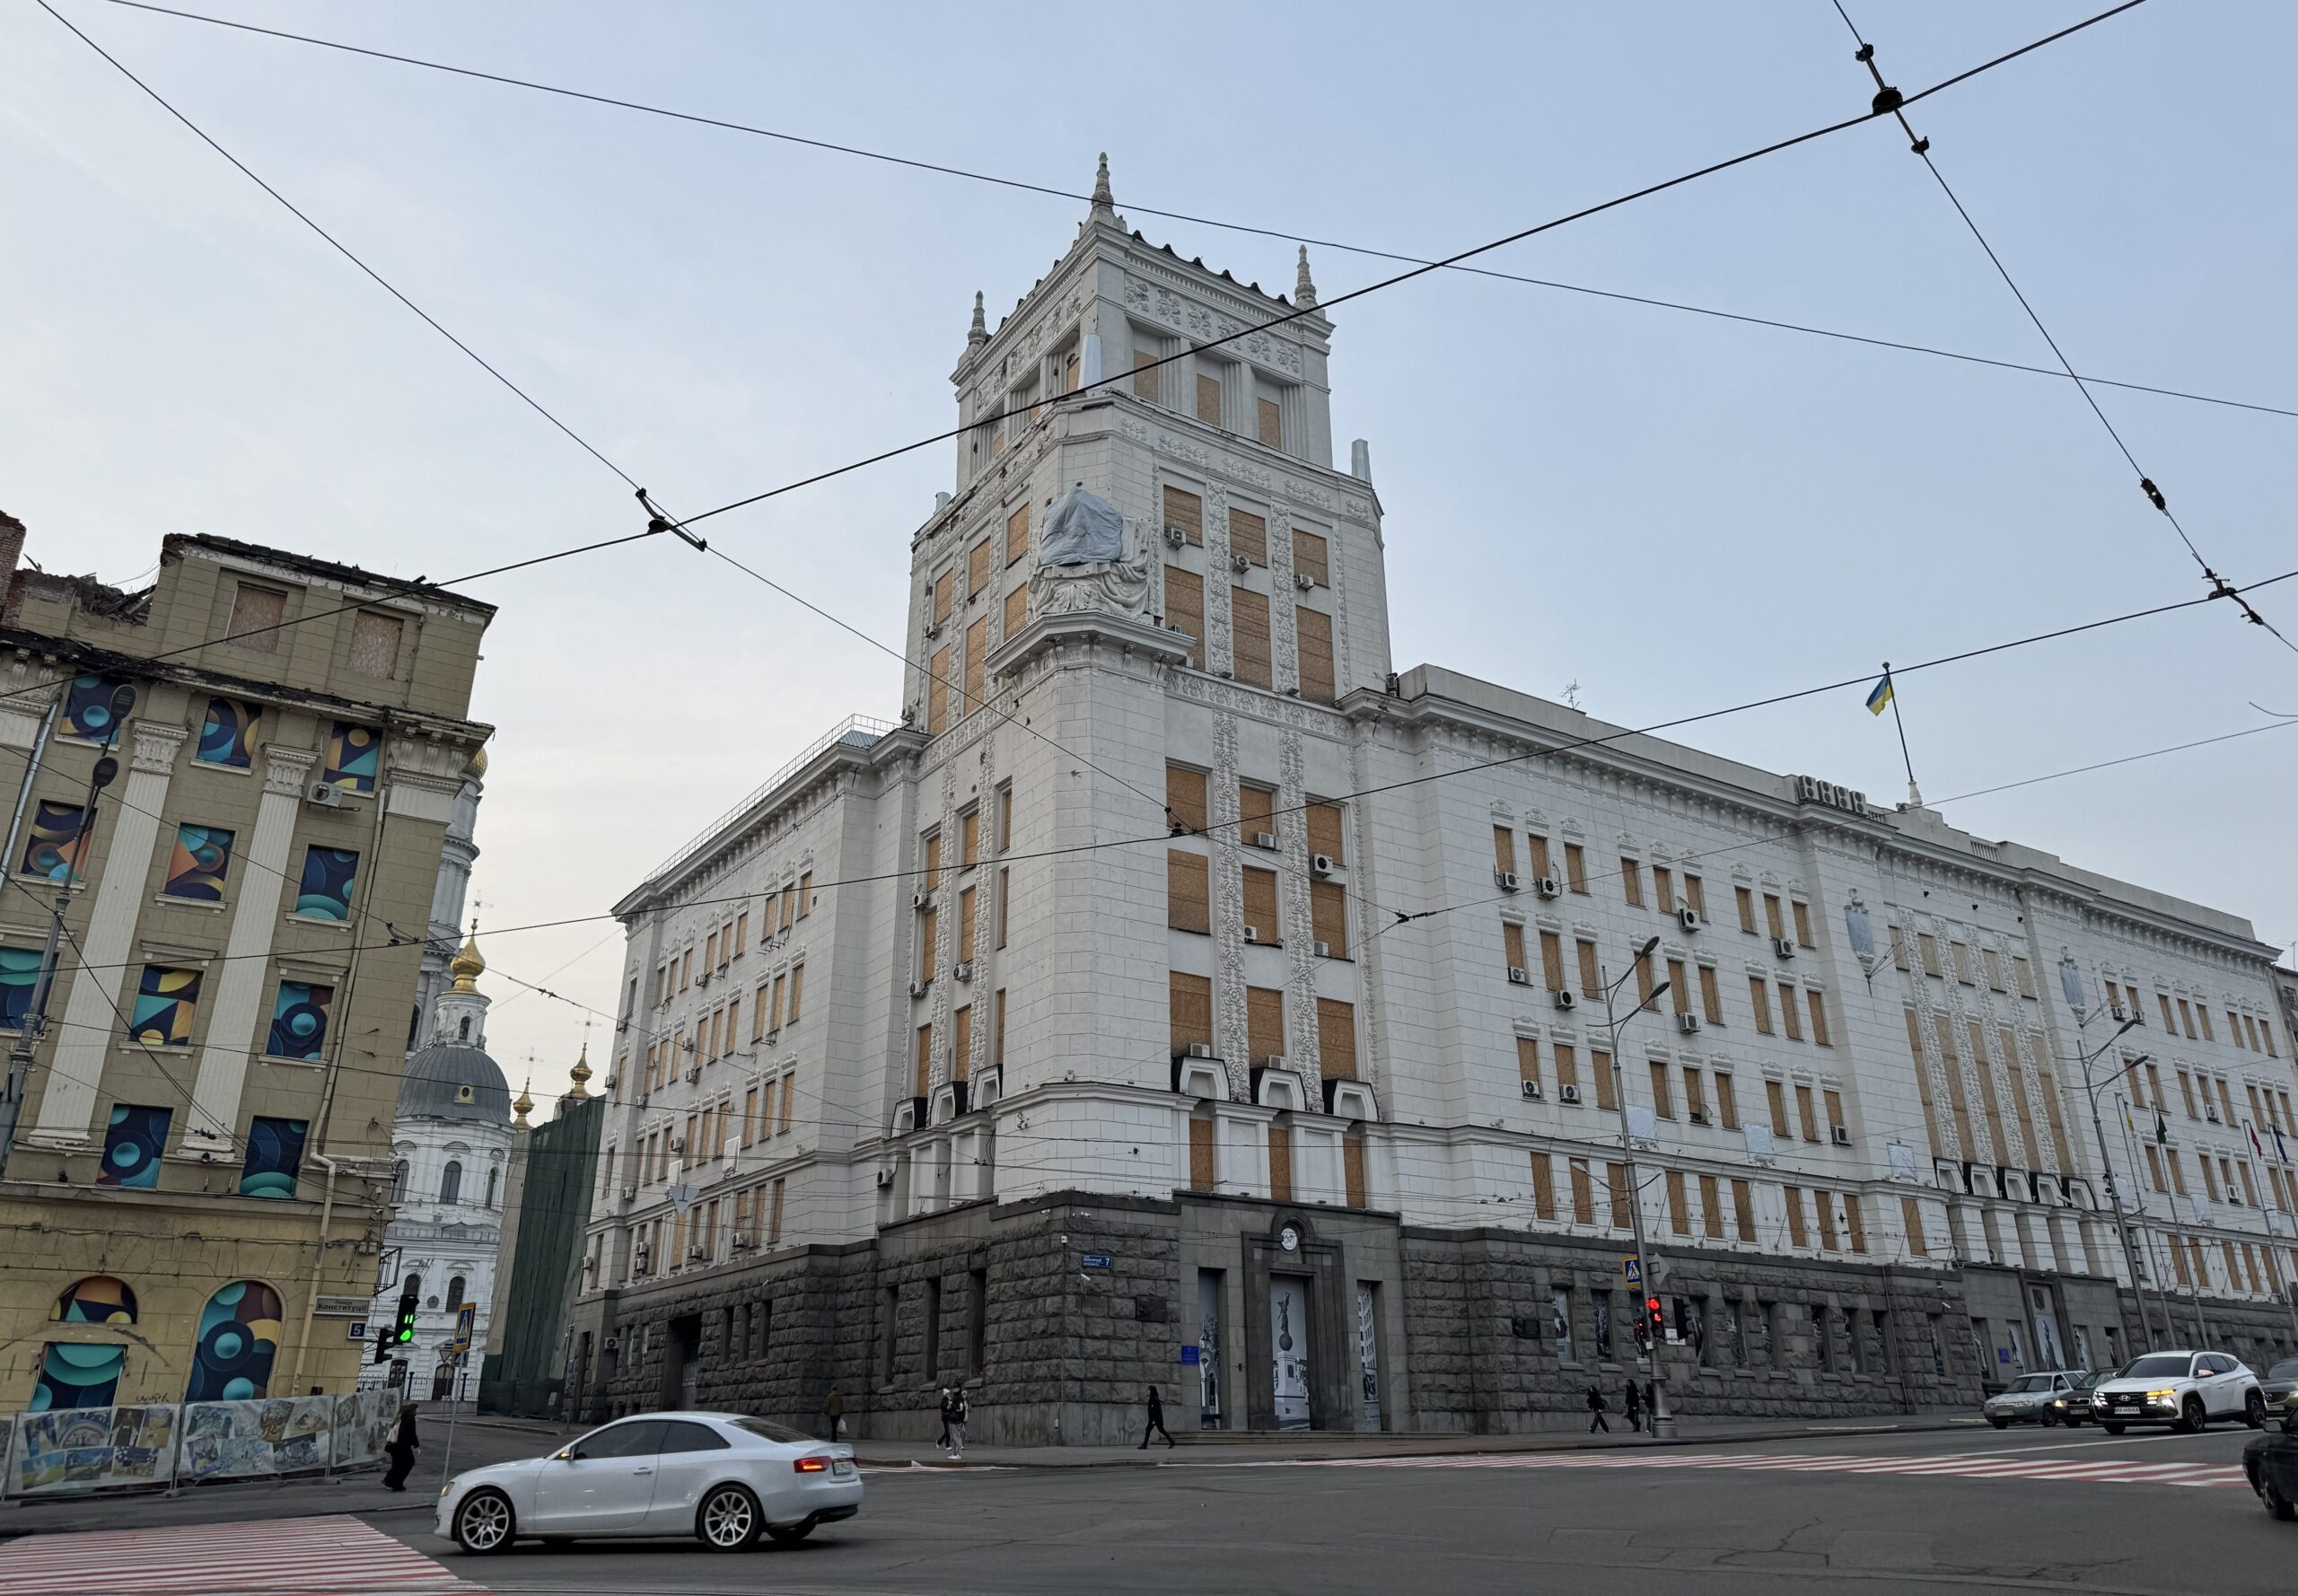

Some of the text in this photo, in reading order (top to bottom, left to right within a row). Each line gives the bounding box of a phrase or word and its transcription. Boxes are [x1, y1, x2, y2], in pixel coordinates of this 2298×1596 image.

[1105, 1258, 1110, 1267] 7
[318, 1302, 367, 1311] Конституції
[353, 1325, 362, 1336] 5
